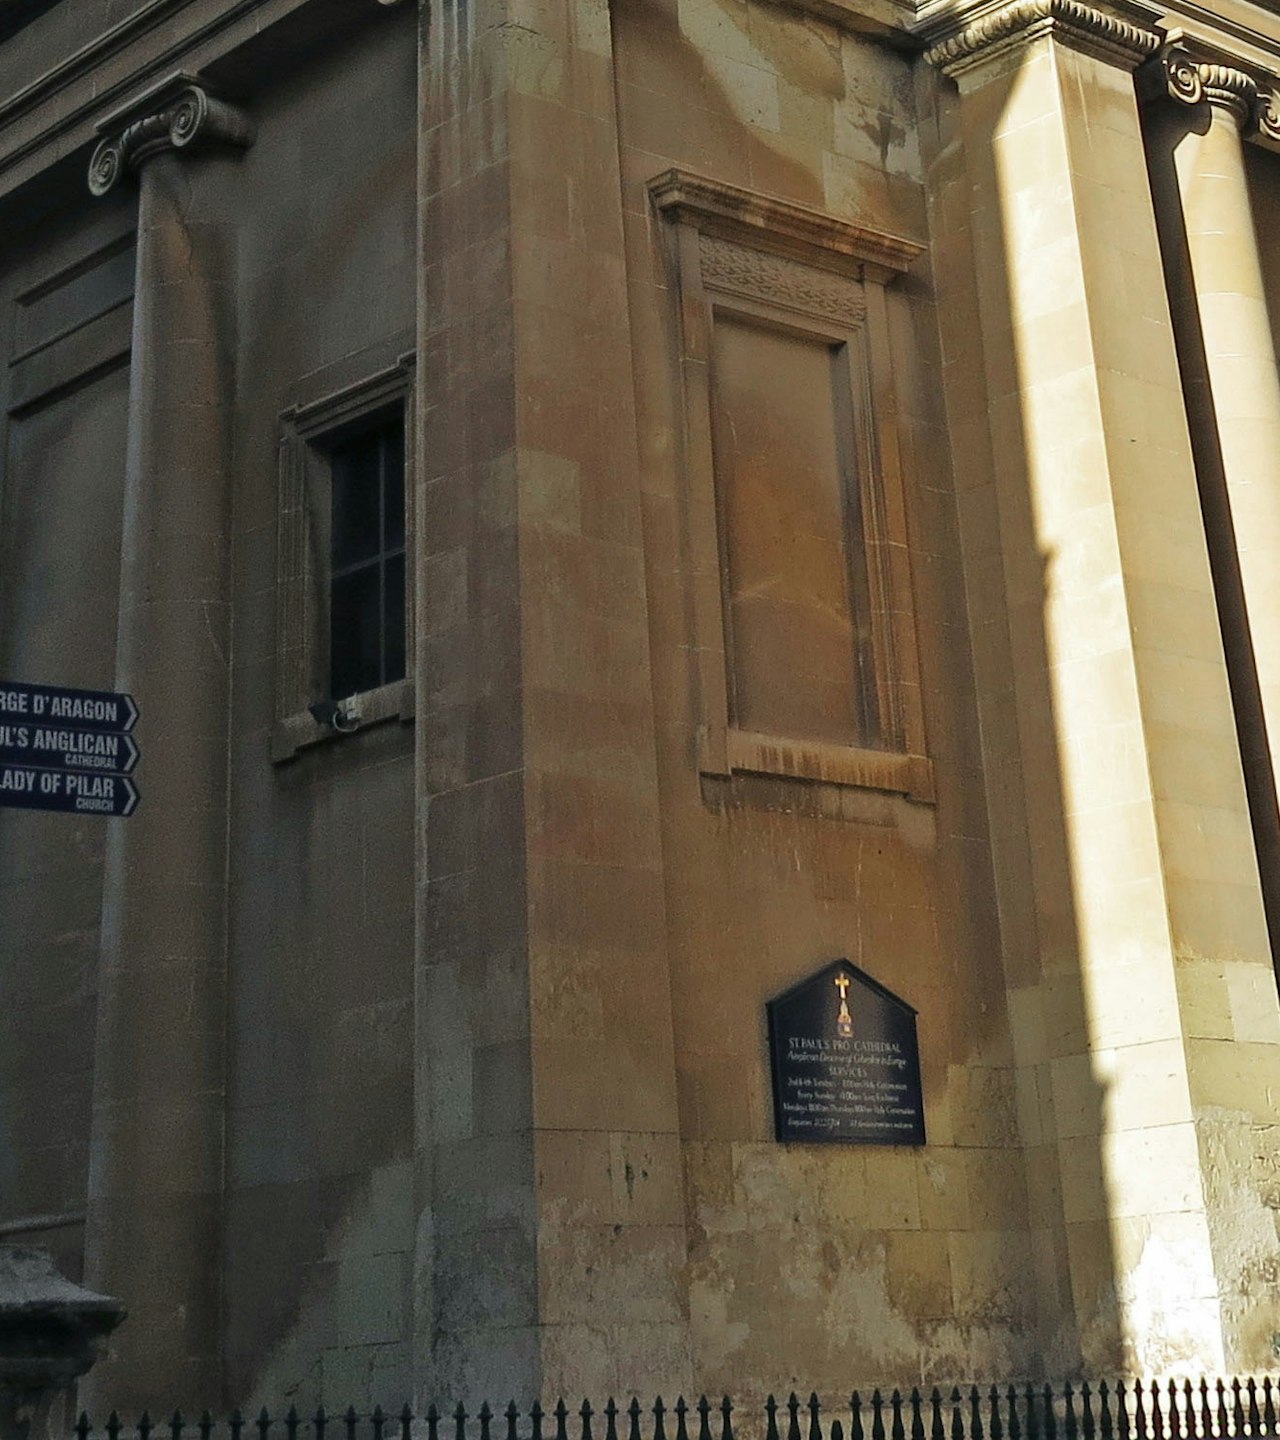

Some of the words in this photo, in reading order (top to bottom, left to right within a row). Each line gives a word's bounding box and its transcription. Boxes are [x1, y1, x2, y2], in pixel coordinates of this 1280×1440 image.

[33, 694, 118, 722] D'ARAGON
[33, 729, 118, 756] ANGLICAN
[65, 753, 117, 770] CATHEDRAL
[40, 773, 61, 794] OF
[66, 774, 115, 798] PILAR
[75, 797, 114, 811] CHURCH
